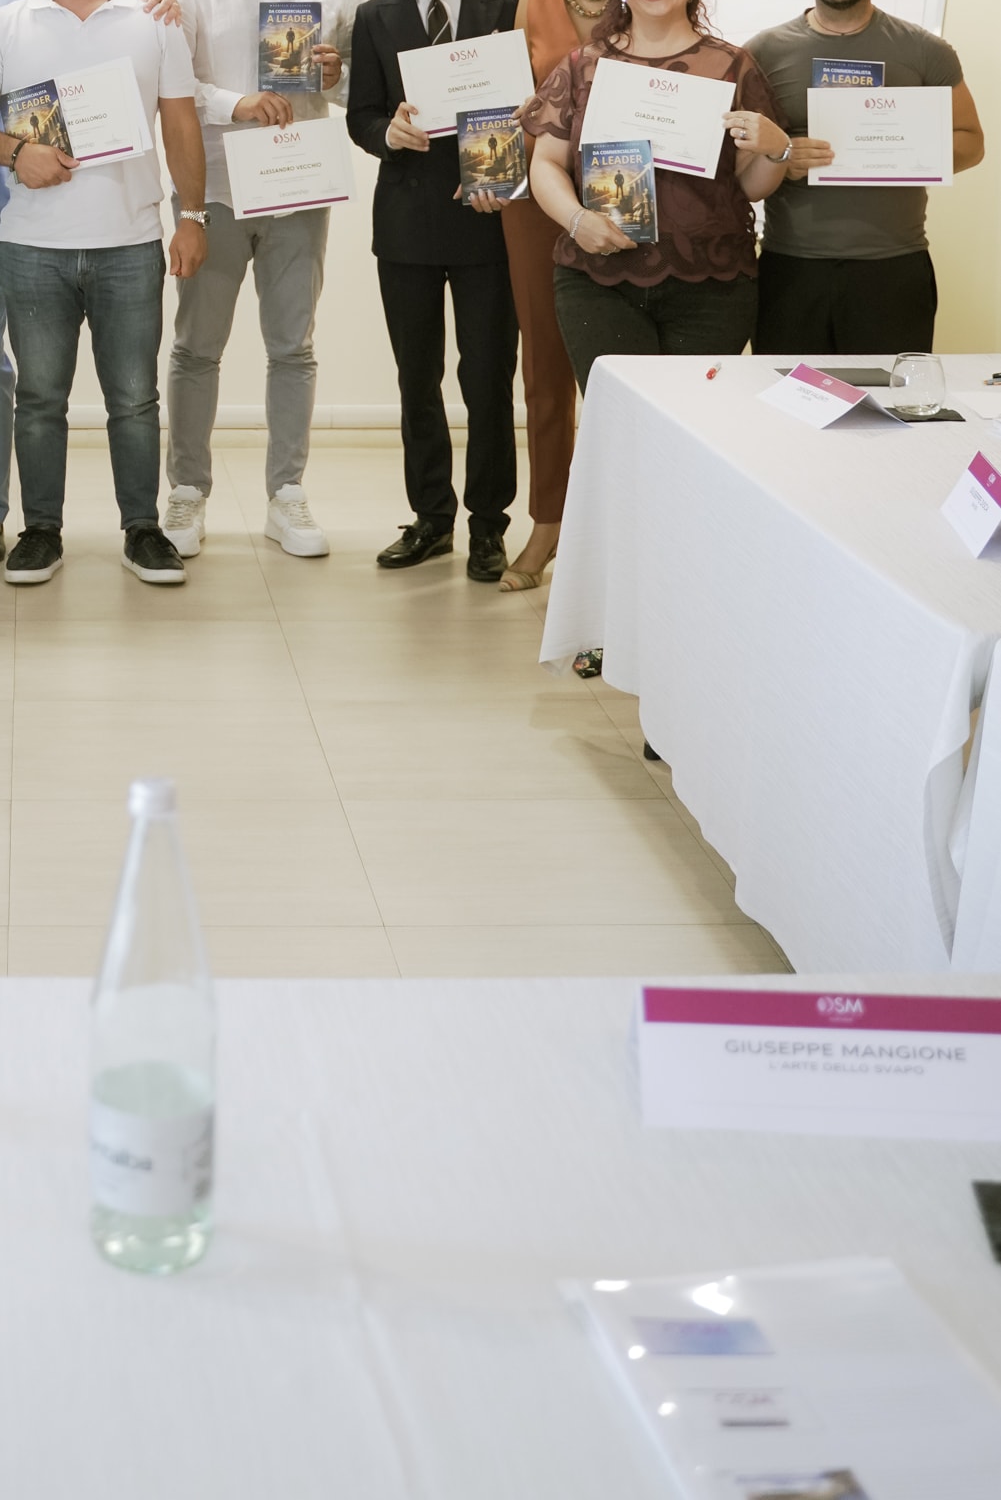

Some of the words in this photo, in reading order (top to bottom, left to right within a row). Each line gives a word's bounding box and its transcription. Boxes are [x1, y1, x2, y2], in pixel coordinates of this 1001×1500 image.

[267, 15, 274, 23] A
[276, 14, 313, 23] LEADER
[449, 48, 478, 62] OSM
[649, 79, 679, 93] OSM
[821, 74, 829, 83] A
[832, 74, 874, 86] LEADER
[447, 85, 467, 93] DENISE
[468, 81, 491, 89] VALENTI
[8, 105, 15, 114] A
[16, 95, 51, 111] LEADER
[864, 98, 896, 109] OSM
[75, 112, 108, 125] GIALLONGO
[634, 111, 655, 121] GIADA
[657, 116, 676, 124] ROTTA
[466, 123, 474, 132] A
[476, 119, 515, 131] LEADER
[273, 132, 301, 144] OSM
[591, 157, 599, 166] A
[602, 155, 643, 166] LEADER
[259, 166, 295, 175] ALESSANDRO
[296, 162, 322, 171] VECCHIO
[816, 996, 864, 1014] OSM
[724, 1039, 834, 1057] GIUSEPPE
[841, 1043, 967, 1062] MANGIONE
[769, 1059, 819, 1072] L'ARTE
[823, 1061, 869, 1074] DELLO
[874, 1063, 925, 1076] SVAPO
